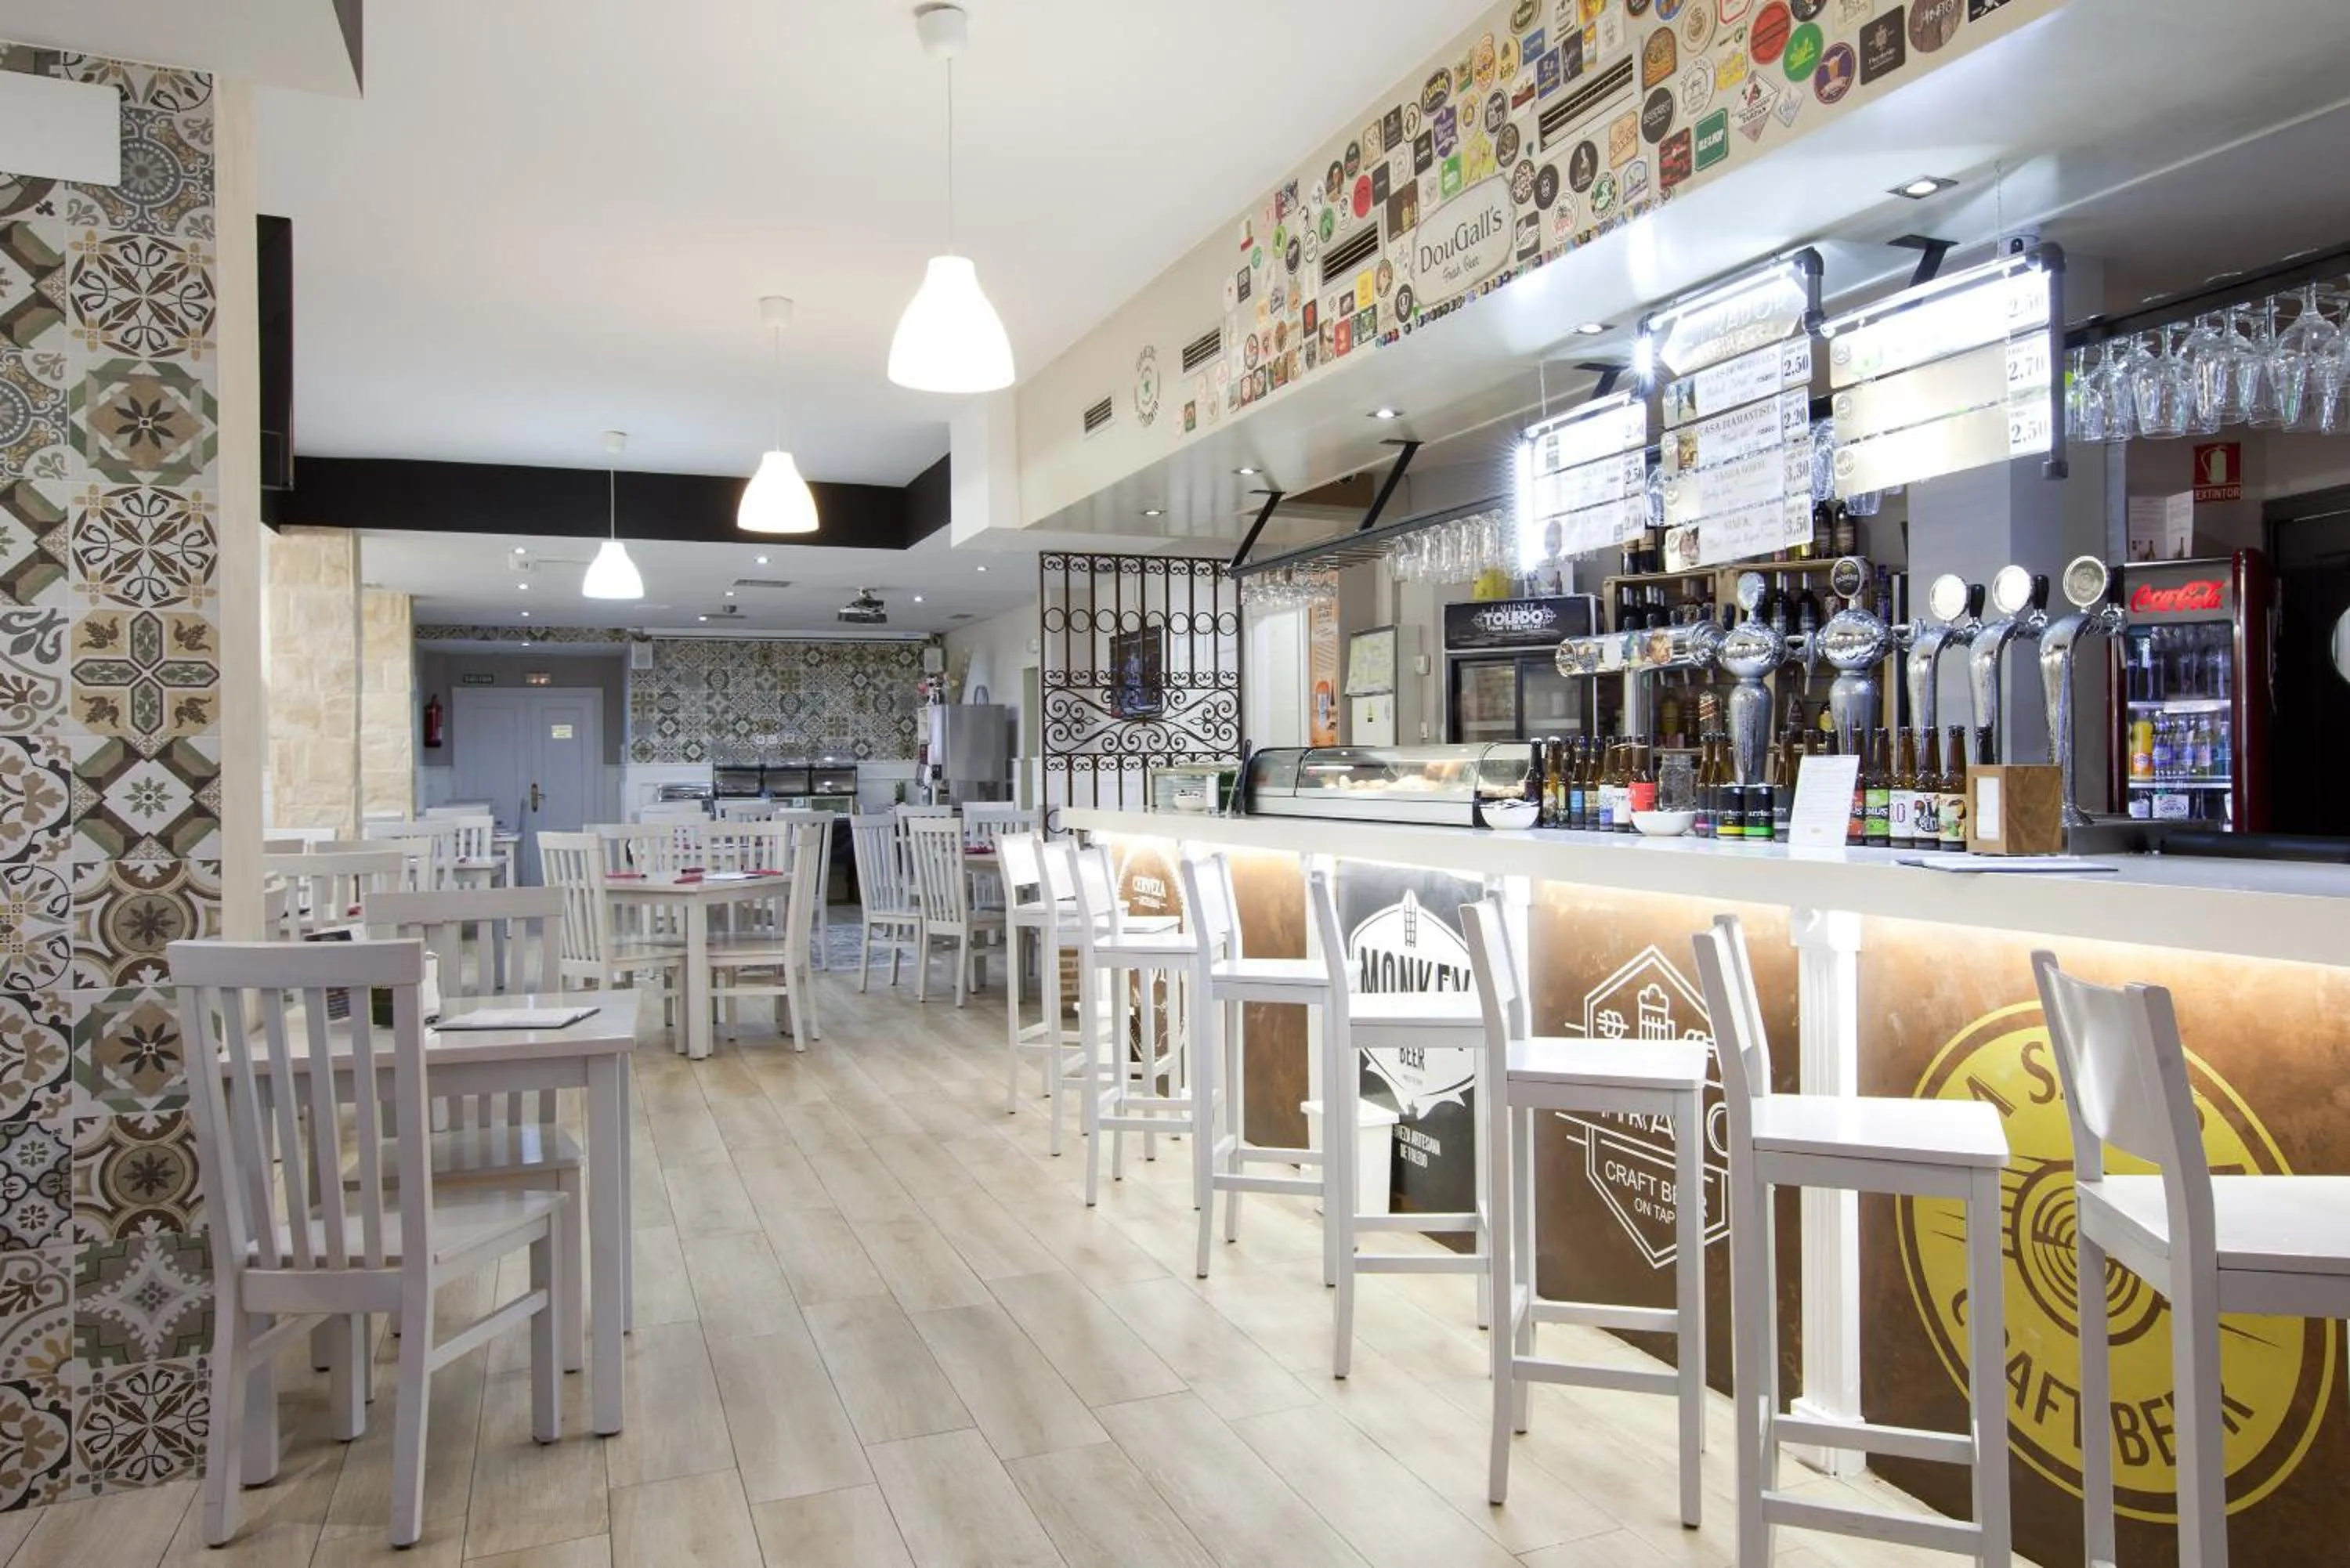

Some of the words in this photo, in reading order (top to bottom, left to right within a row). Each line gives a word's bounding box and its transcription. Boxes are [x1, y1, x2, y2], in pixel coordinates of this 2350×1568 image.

[1419, 205, 1502, 273] DouGall's
[1783, 353, 1810, 377] 2,50
[2195, 487, 2241, 500] EXTINTOR
[2130, 580, 2225, 613] Coca-Cola
[1484, 610, 1544, 626] TOLEDO
[1605, 1159, 1658, 1197] CRAFT
[1634, 1197, 1651, 1216] ON
[1653, 1204, 1676, 1226] TAP
[1951, 1288, 2082, 1449] CAFT
[2110, 1380, 2254, 1468] BER
